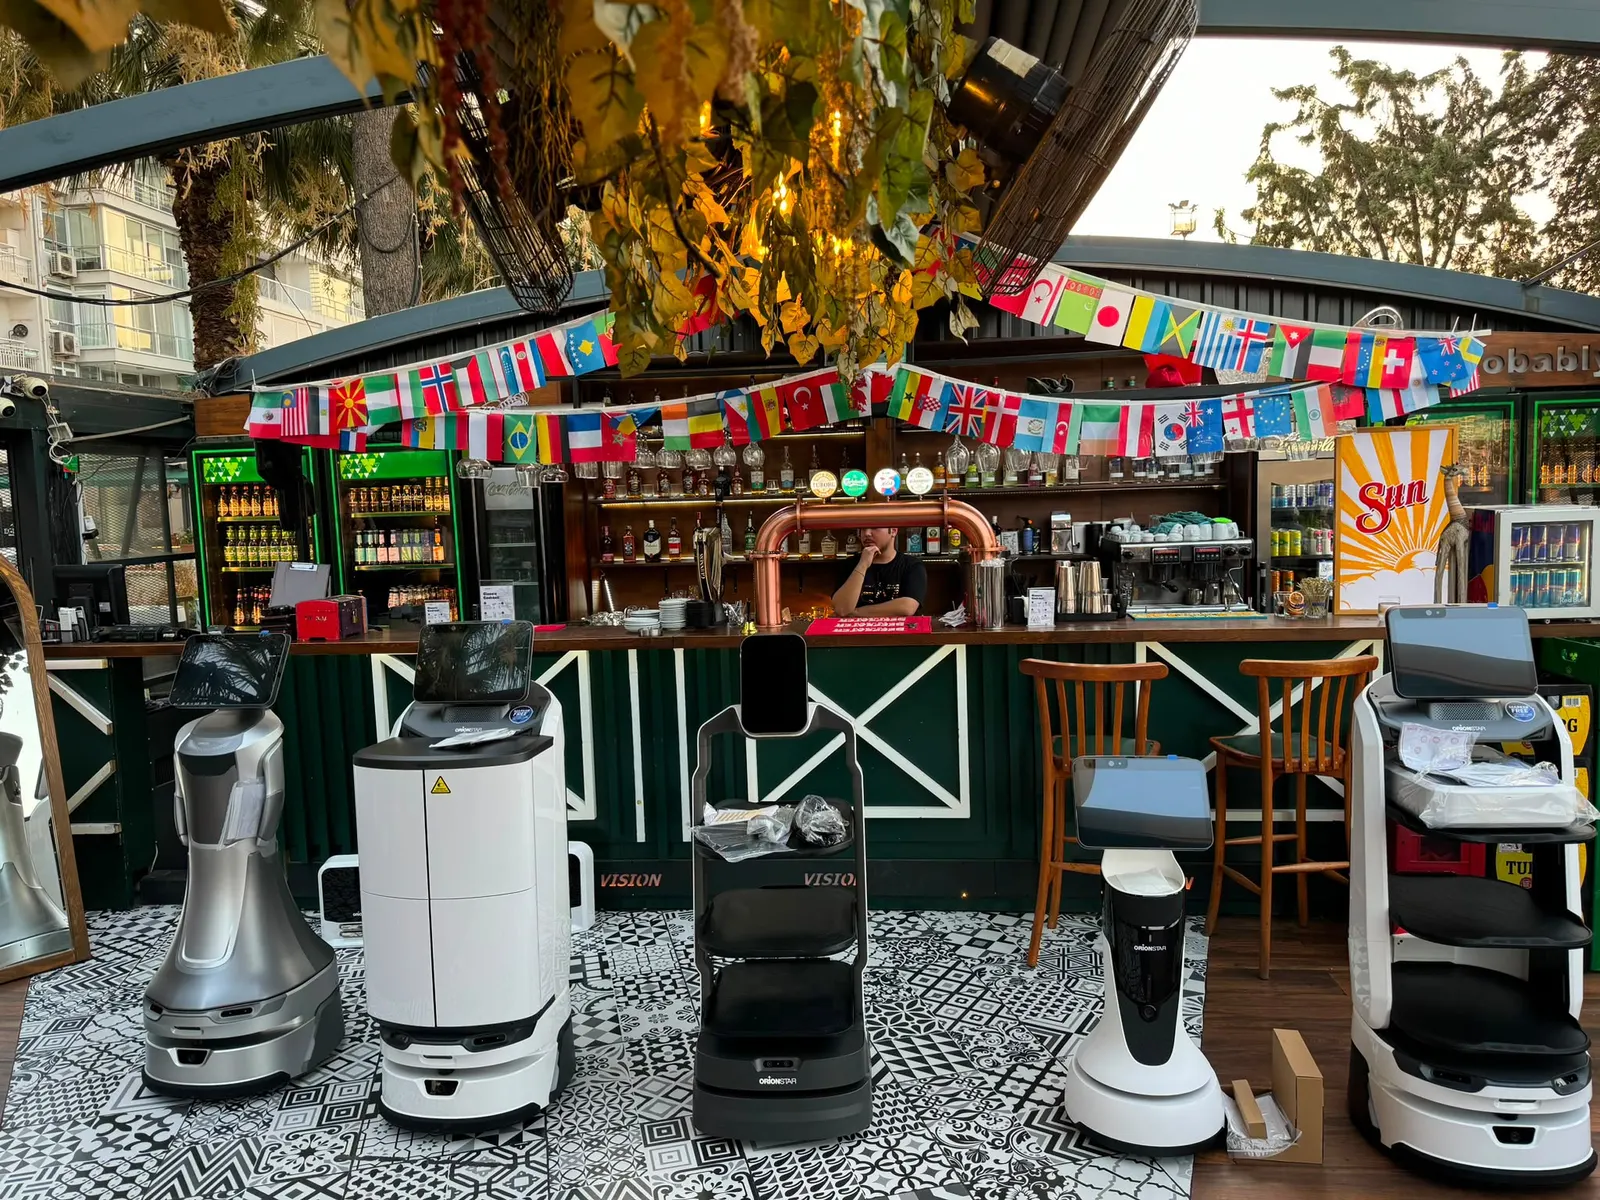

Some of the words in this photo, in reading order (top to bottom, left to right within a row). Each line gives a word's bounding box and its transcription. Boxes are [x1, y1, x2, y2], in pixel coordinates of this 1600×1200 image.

[1356, 480, 1430, 535] Sun
[1506, 861, 1532, 875] TU
[600, 873, 663, 887] VISION
